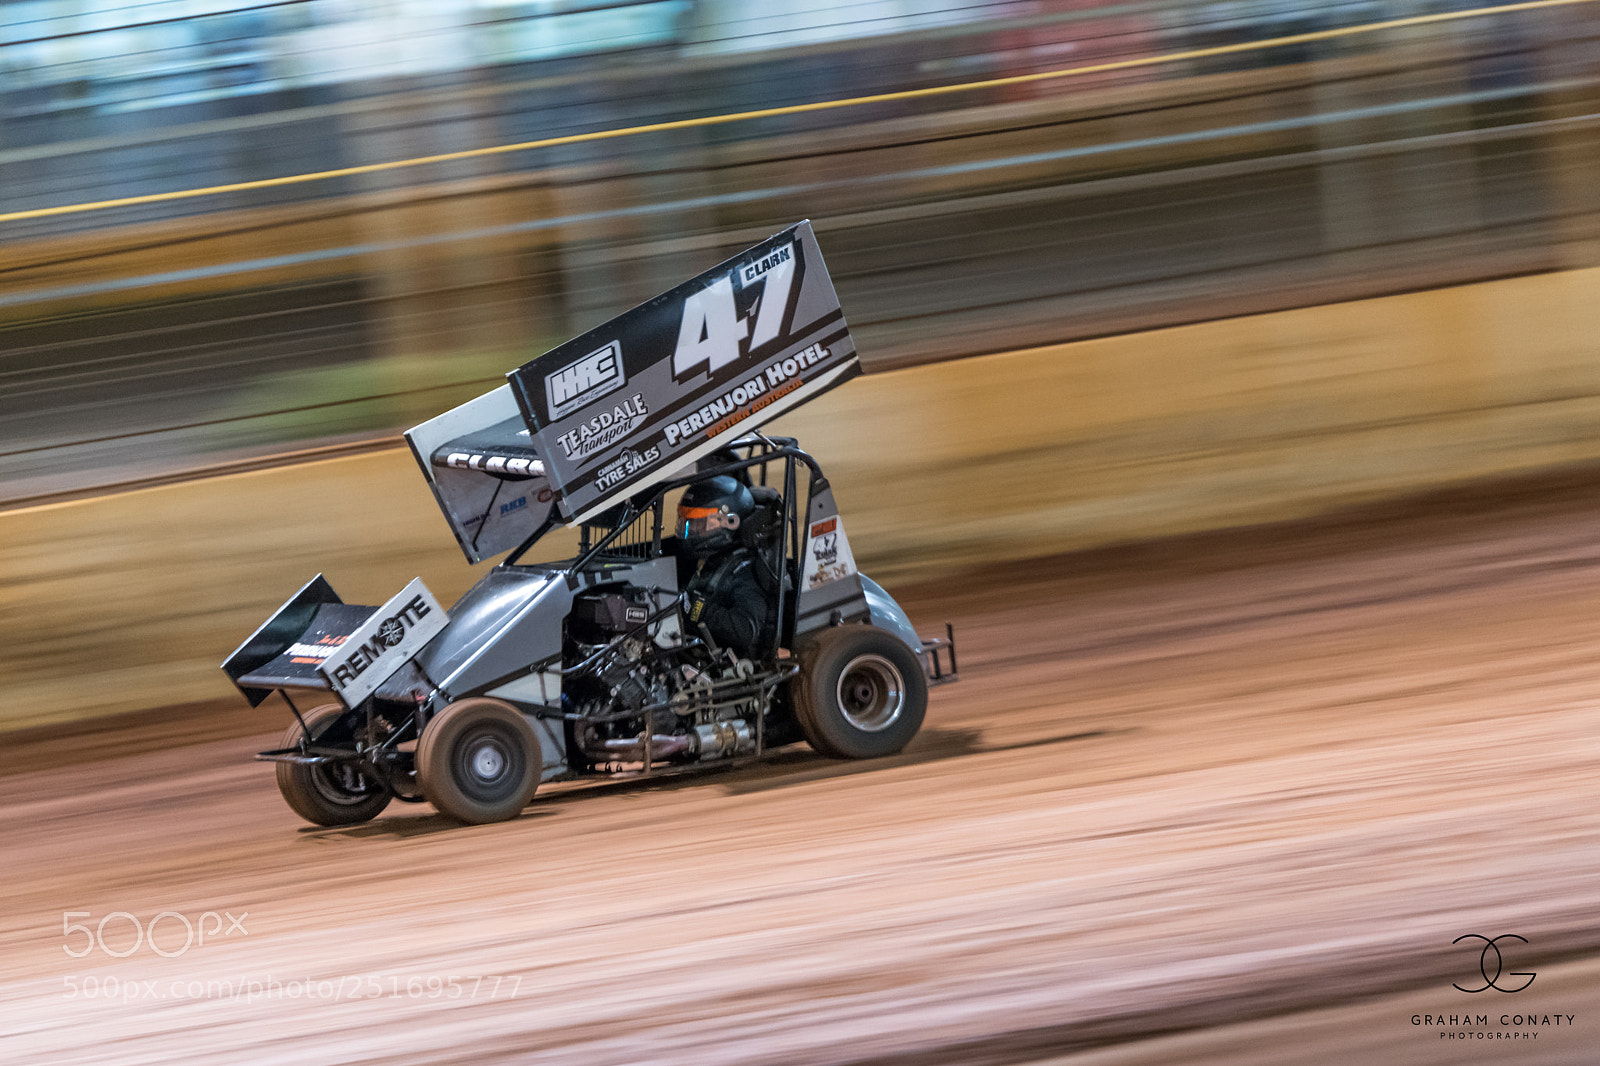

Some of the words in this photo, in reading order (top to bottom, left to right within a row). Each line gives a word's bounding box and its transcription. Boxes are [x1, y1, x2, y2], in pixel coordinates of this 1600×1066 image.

[745, 247, 791, 281] CLARK
[673, 241, 796, 377] 47
[557, 392, 649, 457] TEASDALE
[663, 375, 768, 446] PERENJORI
[765, 342, 830, 387] HOTEL
[705, 408, 751, 439] WESTERN
[751, 378, 804, 414] AUSTRALIA
[579, 417, 634, 455] Transport
[594, 466, 626, 491] TYRE
[625, 446, 660, 474] SALES
[329, 593, 433, 691] REMOTE
